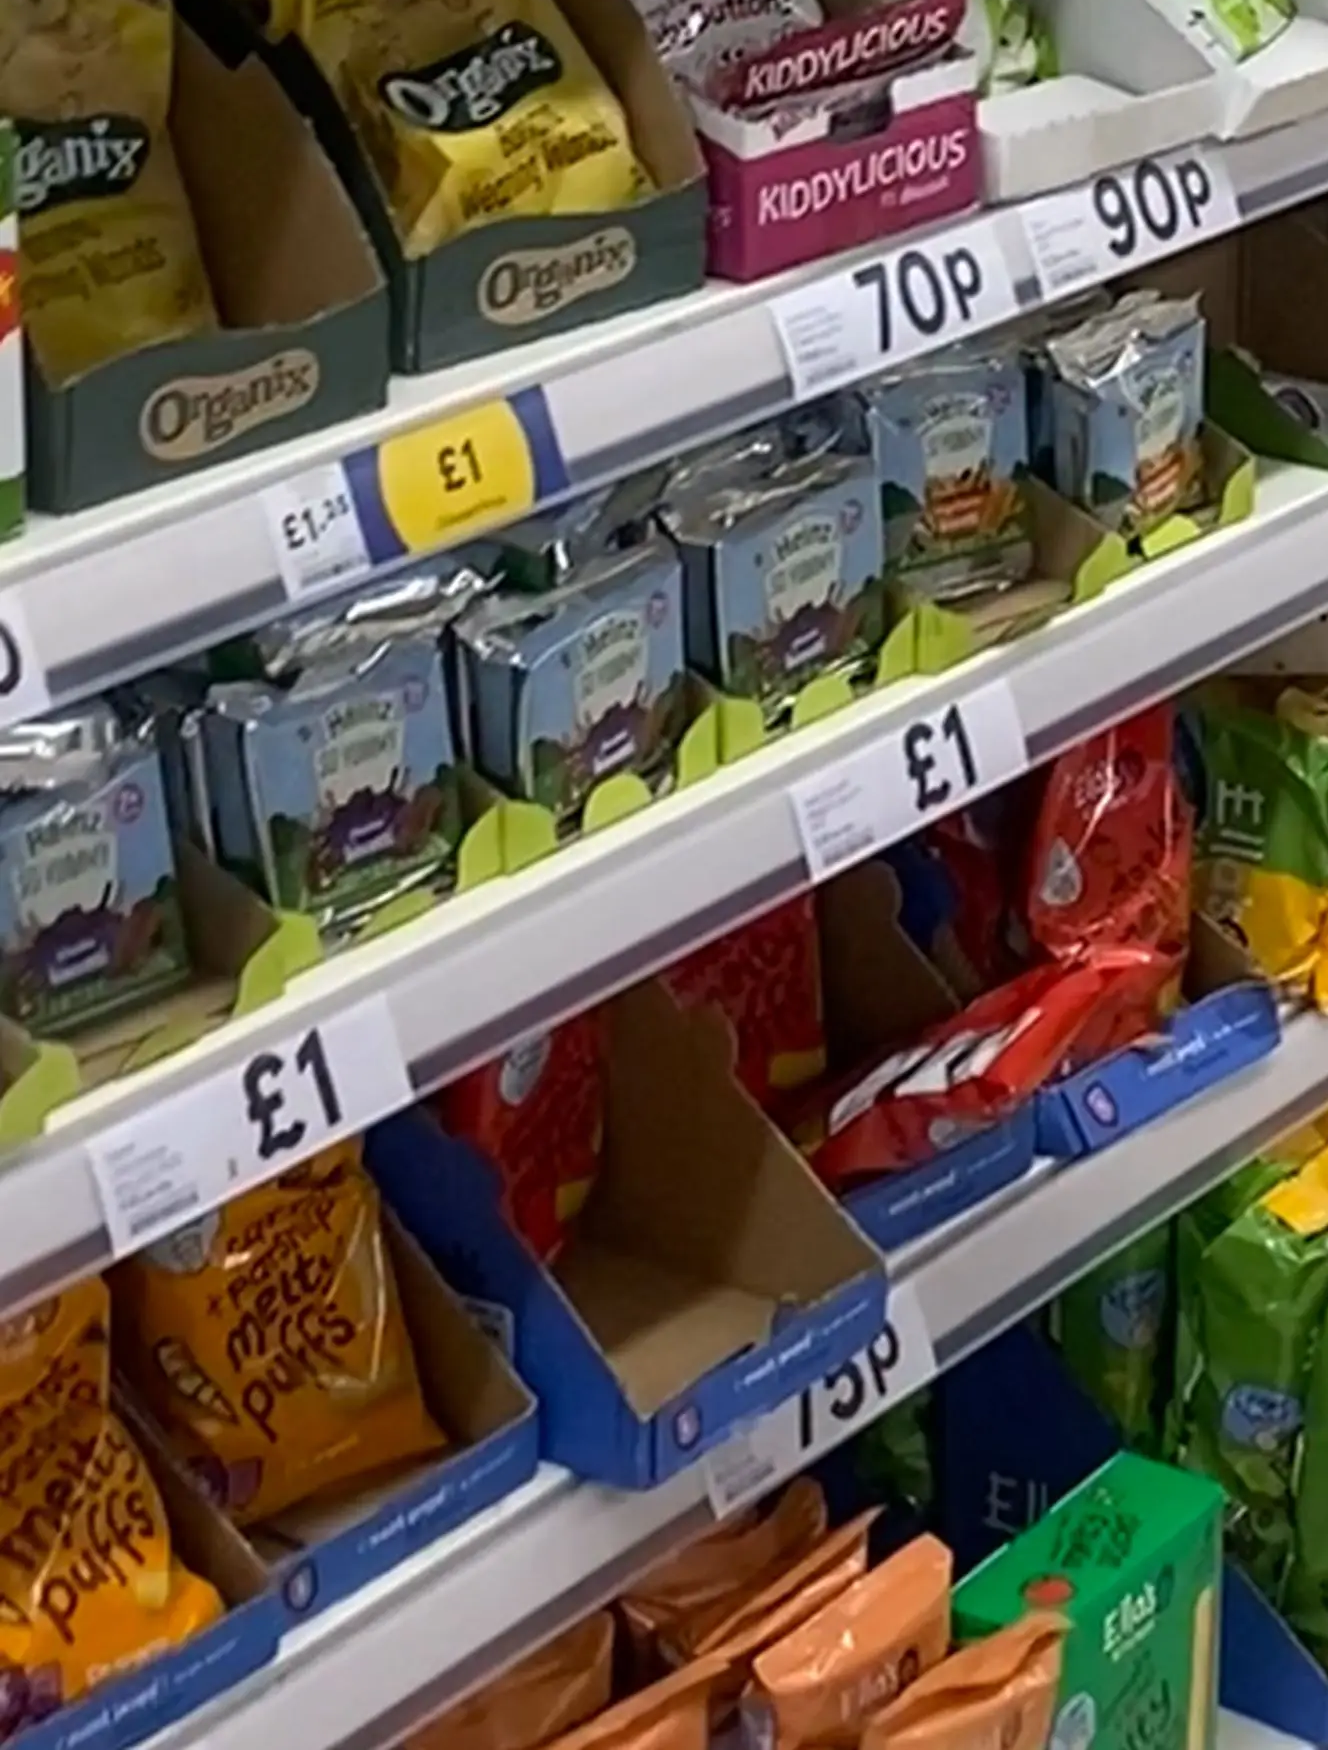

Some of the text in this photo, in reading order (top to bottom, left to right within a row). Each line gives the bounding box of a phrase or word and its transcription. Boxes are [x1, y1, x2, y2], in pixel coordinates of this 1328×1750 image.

[386, 28, 556, 131] Organix
[745, 8, 950, 100] KIDDYLICIOUS
[15, 122, 143, 210] ganix
[757, 126, 971, 228] KIDDYLICIOUS
[1093, 156, 1212, 258] 90p
[485, 230, 630, 311] Organix
[854, 246, 984, 352] 70p
[148, 350, 312, 441] Organix
[436, 437, 483, 493] £1
[901, 703, 982, 812] £1
[241, 1026, 345, 1161] £1
[240, 1301, 357, 1445] puffs
[40, 1486, 156, 1646] puffs
